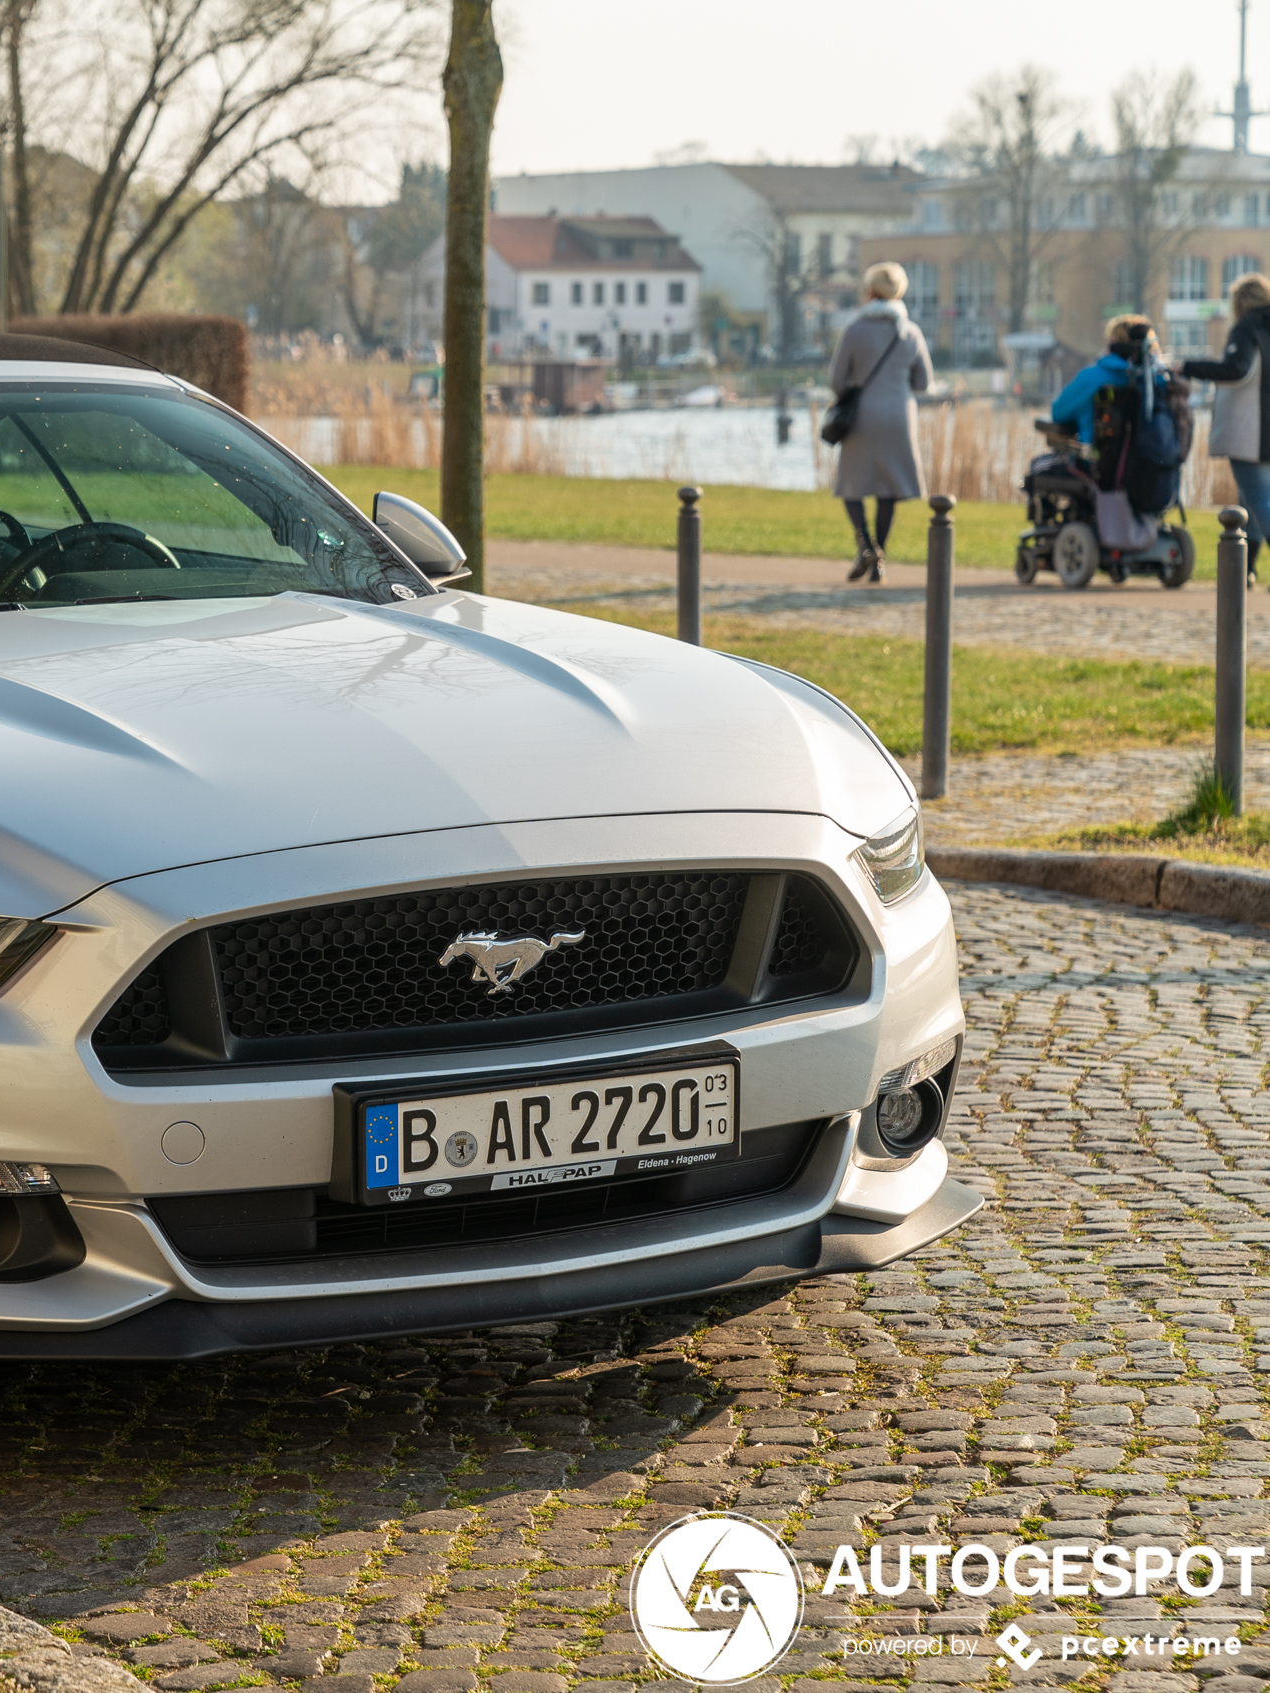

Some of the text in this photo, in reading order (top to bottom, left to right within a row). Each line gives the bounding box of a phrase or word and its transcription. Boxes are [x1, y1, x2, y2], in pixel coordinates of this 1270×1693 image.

[704, 1073, 728, 1093] 03
[402, 1078, 700, 1174] B AR 2720
[706, 1117, 728, 1137] 10
[375, 1155, 388, 1173] D
[637, 1152, 718, 1170] Eldena Hagenow
[508, 1165, 602, 1186] HALFPAP
[428, 1185, 448, 1195] Ford
